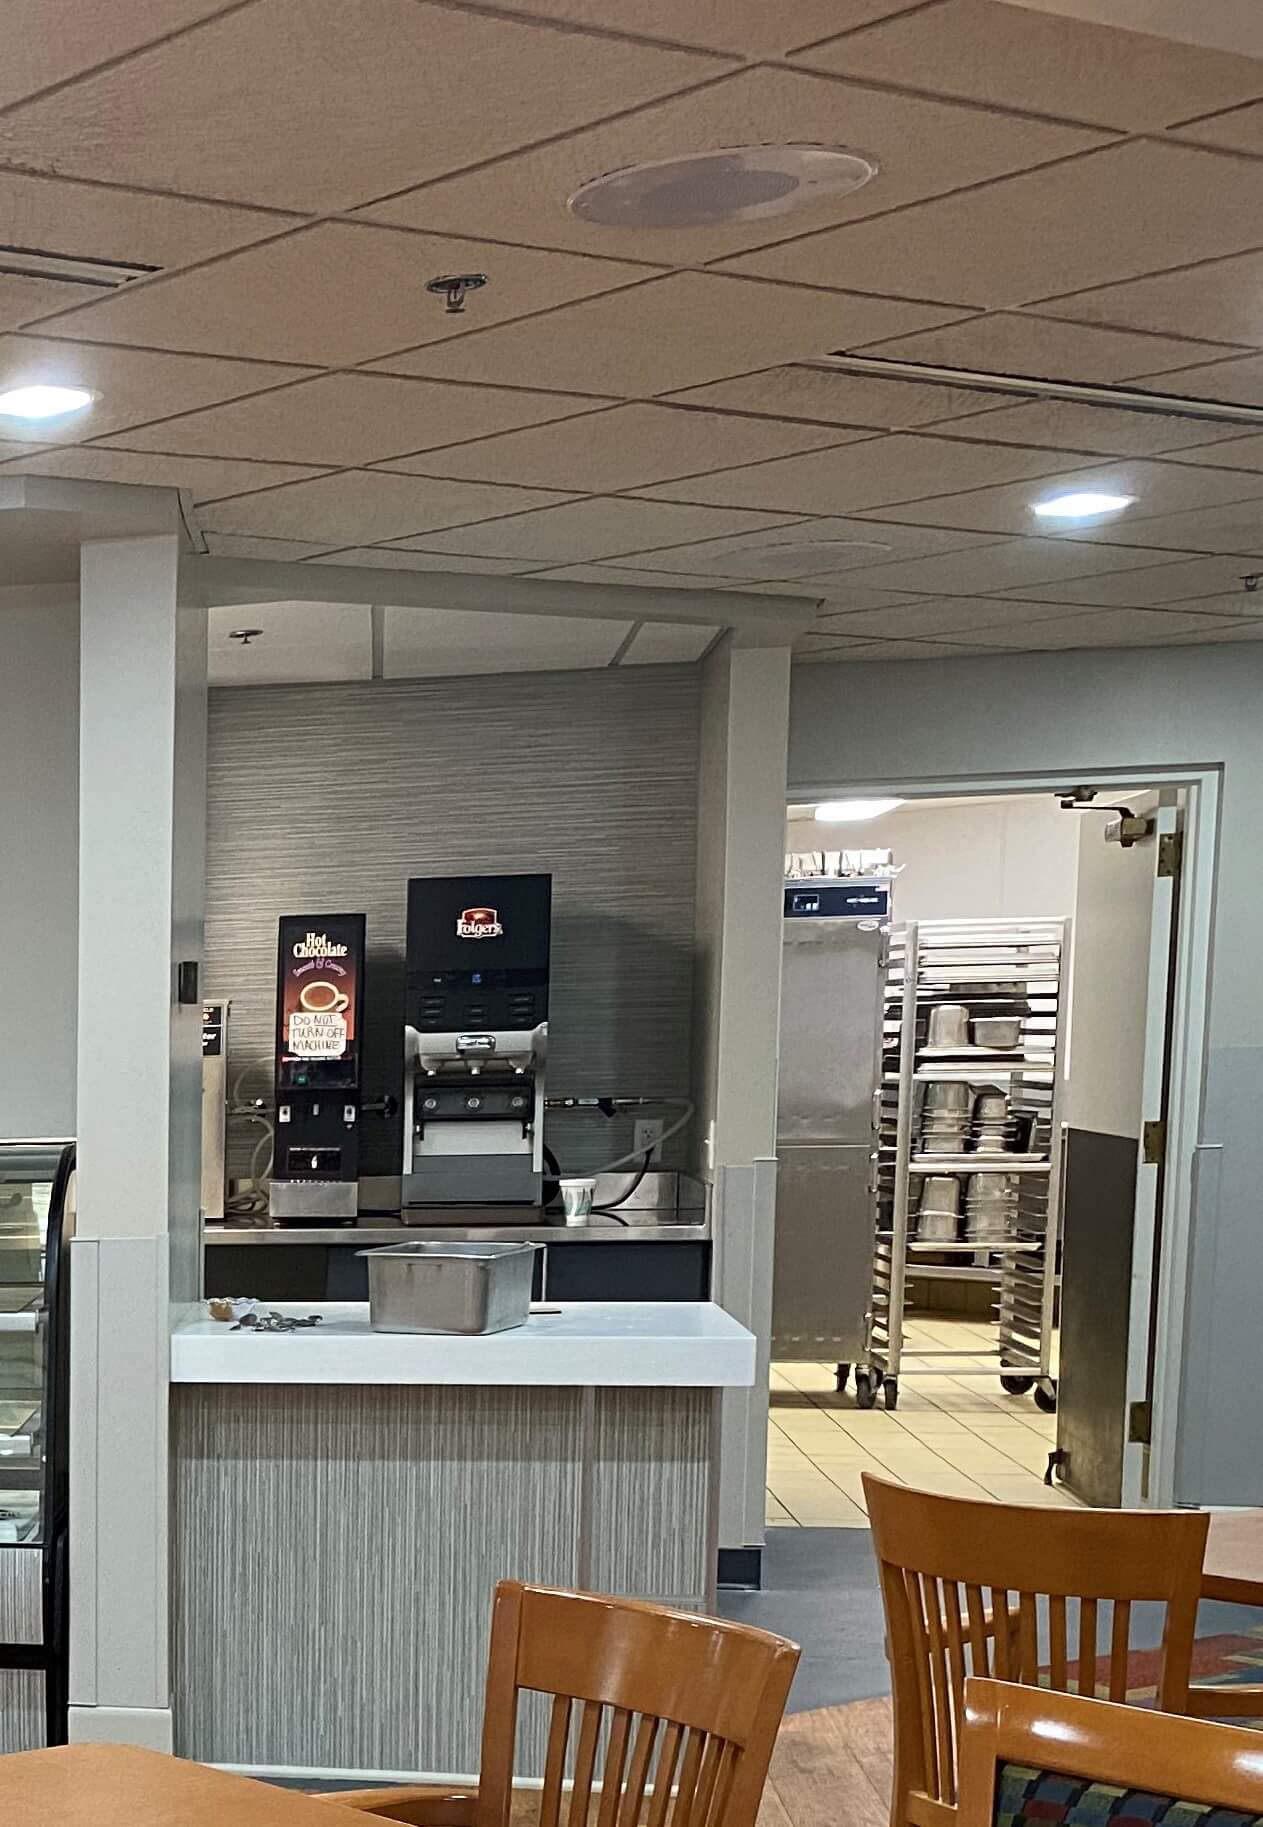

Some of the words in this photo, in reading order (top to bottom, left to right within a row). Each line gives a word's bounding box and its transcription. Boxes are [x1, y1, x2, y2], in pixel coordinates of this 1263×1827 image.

[456, 919, 503, 937] Folgers
[306, 932, 327, 948] Hot
[293, 942, 348, 958] Chocolate
[293, 1014, 311, 1026] DO
[314, 1014, 337, 1026] NOT
[292, 1027, 324, 1039] TURN
[327, 1027, 345, 1038] OFF
[292, 1039, 340, 1051] MACHINE
